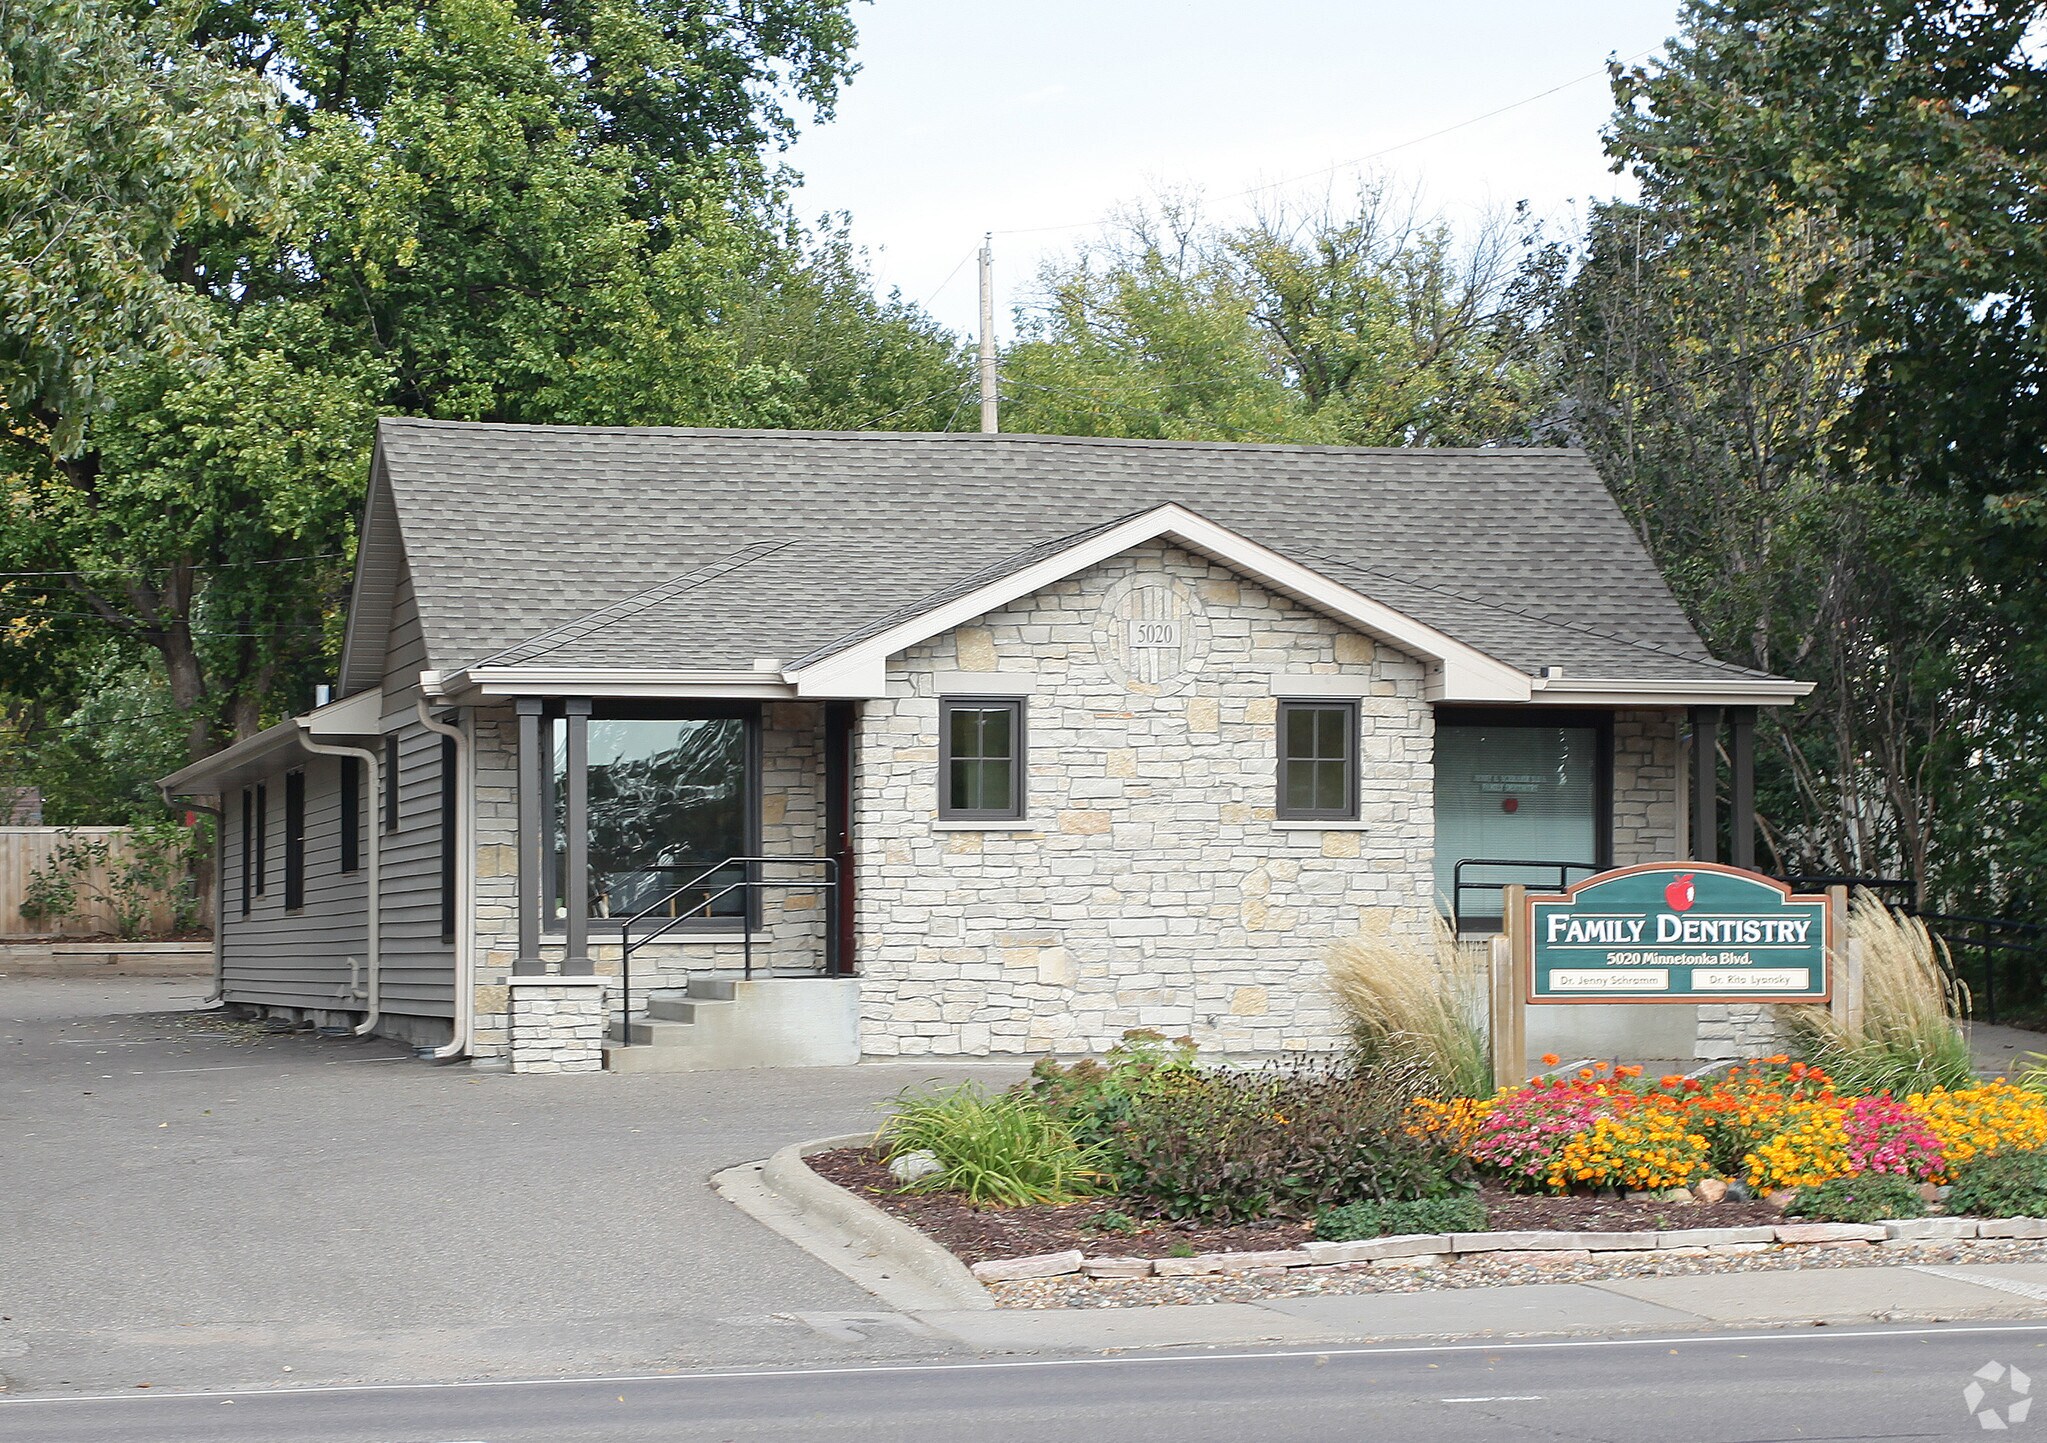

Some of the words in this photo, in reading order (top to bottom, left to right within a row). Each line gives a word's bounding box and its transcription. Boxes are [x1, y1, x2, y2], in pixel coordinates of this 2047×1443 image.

[1137, 624, 1173, 644] 5020
[1546, 914, 1646, 943] FAMILY
[1656, 913, 1812, 943] DENTISTRY
[1606, 952, 1641, 966] 5020
[1641, 951, 1718, 966] Minnetonka
[1719, 951, 1753, 965] Blvd.
[1560, 975, 1575, 986] Dr.
[1578, 975, 1609, 989] Jenny
[1610, 975, 1659, 986] Schramm
[1709, 975, 1725, 985] Dr.
[1727, 974, 1747, 985] Rita
